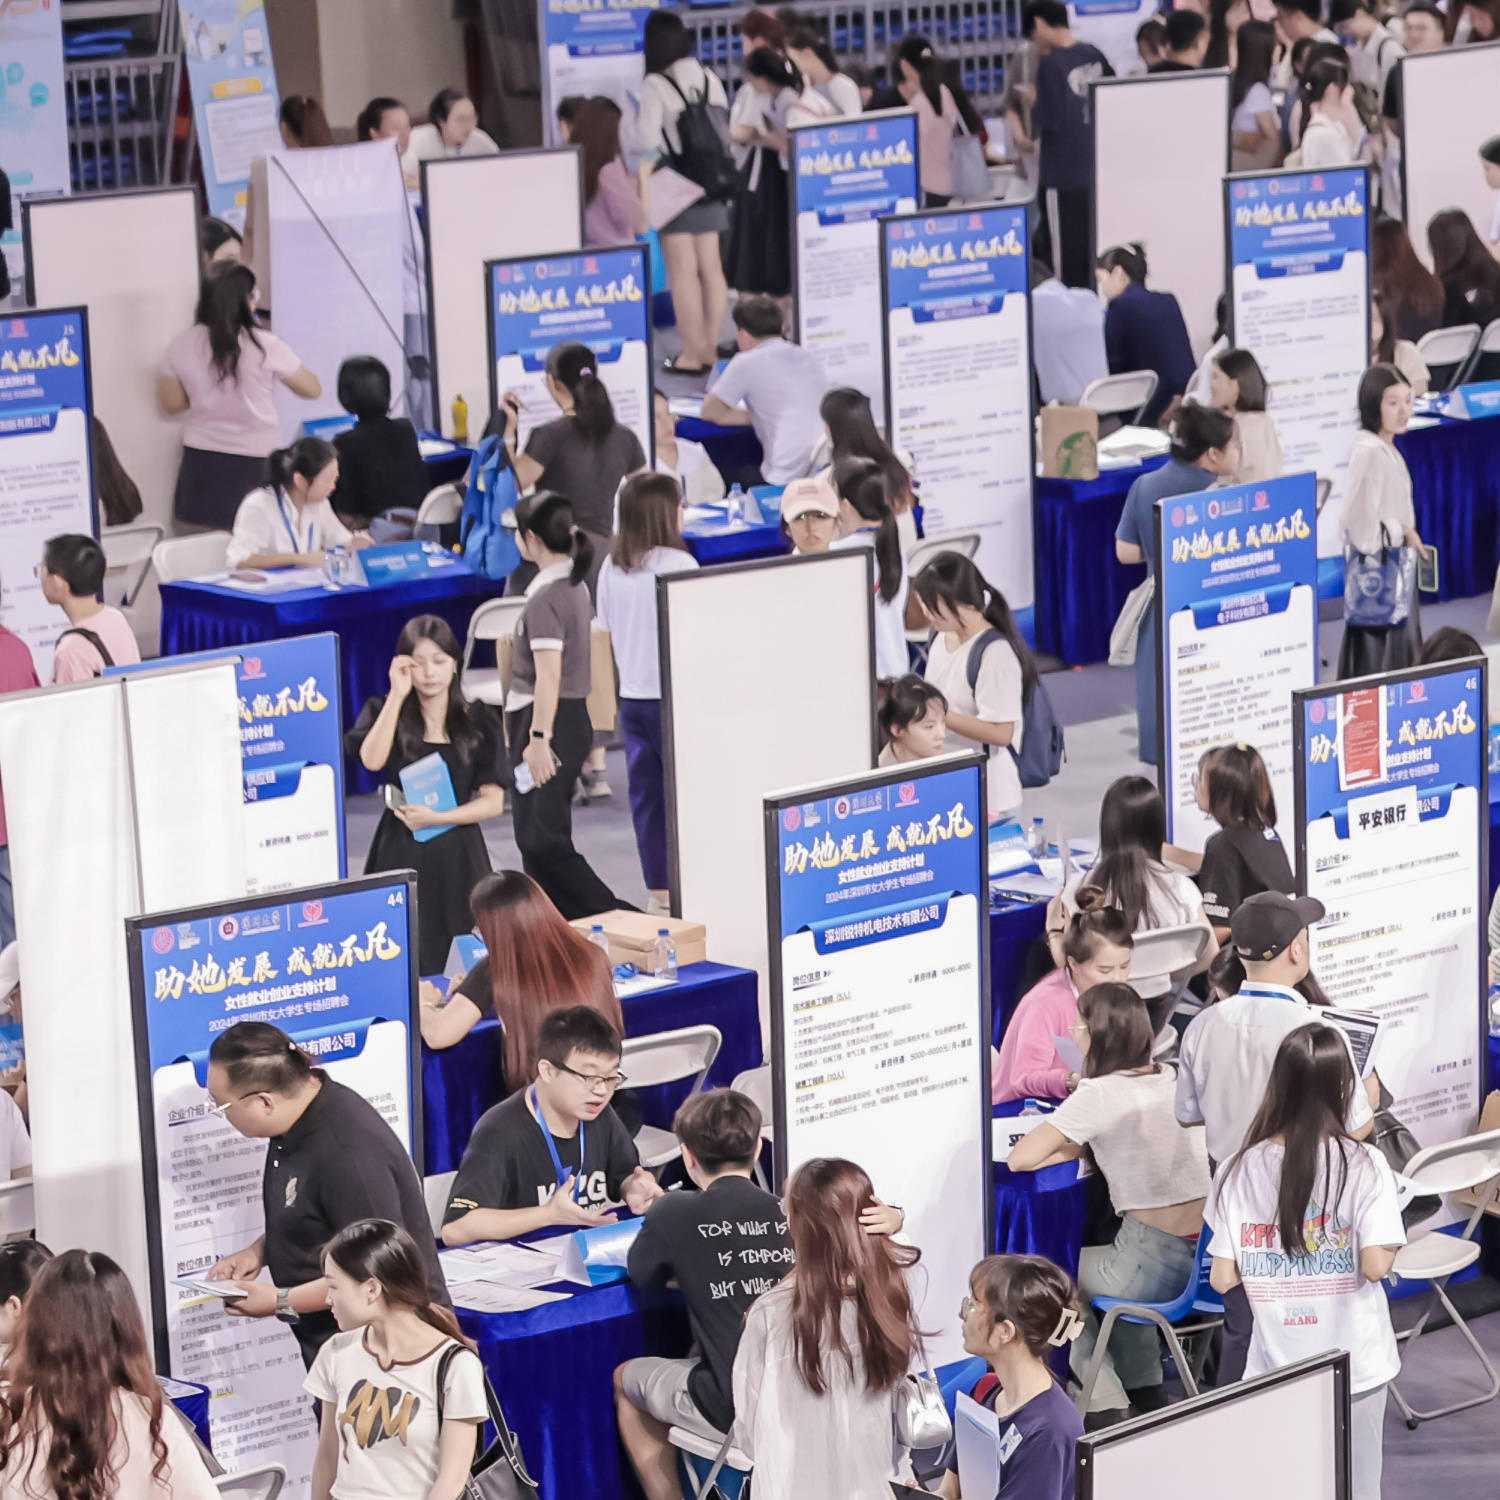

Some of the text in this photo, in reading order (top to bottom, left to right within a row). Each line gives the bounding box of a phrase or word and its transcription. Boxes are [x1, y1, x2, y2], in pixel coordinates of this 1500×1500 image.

[1171, 508, 1311, 563] 助她发展 成就不凡
[1465, 678, 1477, 690] 46
[1398, 700, 1477, 745] 成就不凡
[1359, 804, 1407, 830] 平安银行
[784, 802, 974, 875] 助她发展 成就不凡
[838, 854, 925, 885] 女性就业创业支持计划
[1315, 854, 1341, 869] 企业介绍
[388, 892, 404, 907] 44
[825, 871, 935, 905] 2024年深圳市女大学生专场招聘会
[825, 905, 939, 945] 深圳锐特机电技术有限公司
[154, 921, 401, 1001] 助她发展 成就不凡
[792, 972, 821, 986] 岗位信息
[225, 977, 336, 1011] 女性就业创业支持计划
[168, 1103, 205, 1121] 企业介绍
[698, 1221, 732, 1238] FOR
[737, 1220, 770, 1236] WHAT
[177, 1255, 213, 1273] 岗位信息
[718, 1251, 732, 1267] IS
[1241, 1248, 1355, 1278] HAPPINESS
[709, 1280, 734, 1300] BUT
